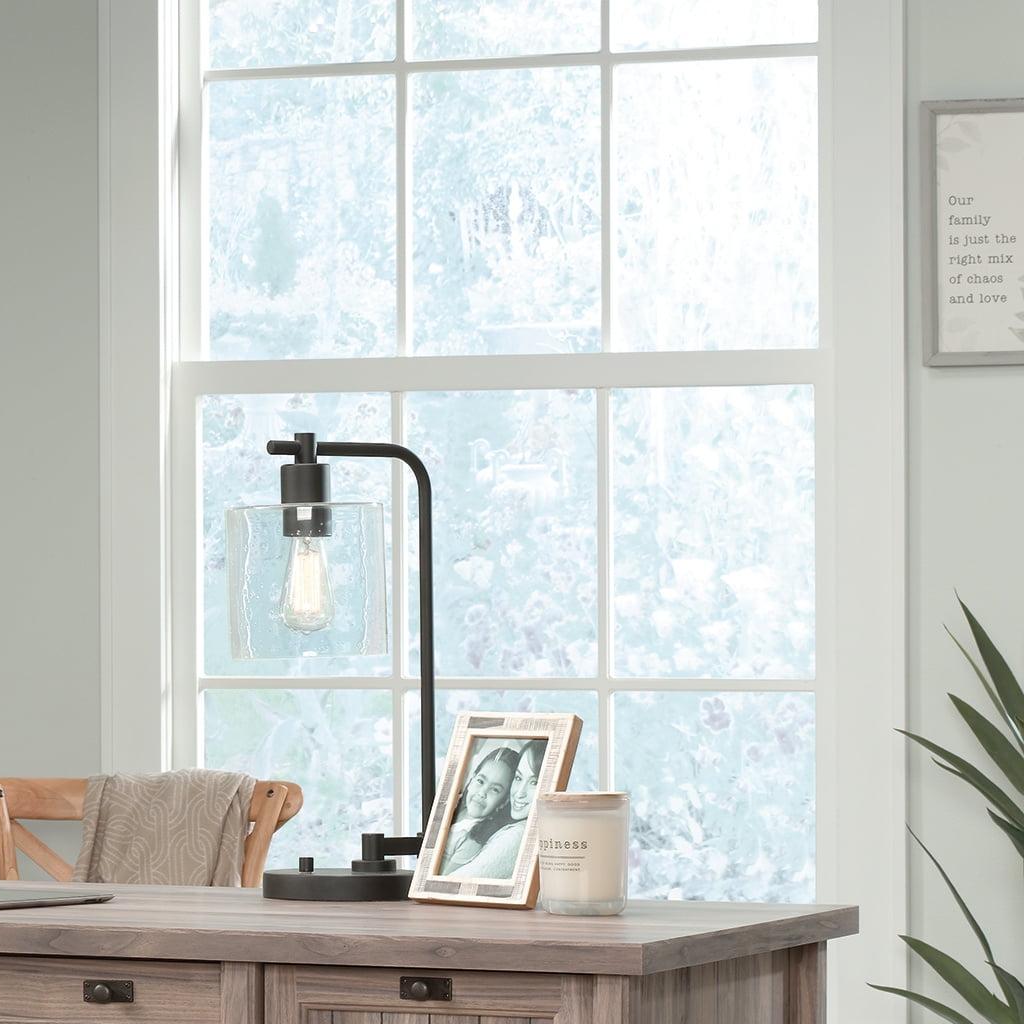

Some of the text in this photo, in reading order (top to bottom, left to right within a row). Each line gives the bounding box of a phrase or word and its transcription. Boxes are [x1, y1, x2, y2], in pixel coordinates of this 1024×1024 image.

[948, 195, 974, 206] Our
[949, 215, 991, 226] family
[949, 233, 1017, 247] is just the
[949, 253, 1014, 266] right mix
[949, 273, 1004, 284] of chaos
[949, 293, 1008, 304] and love
